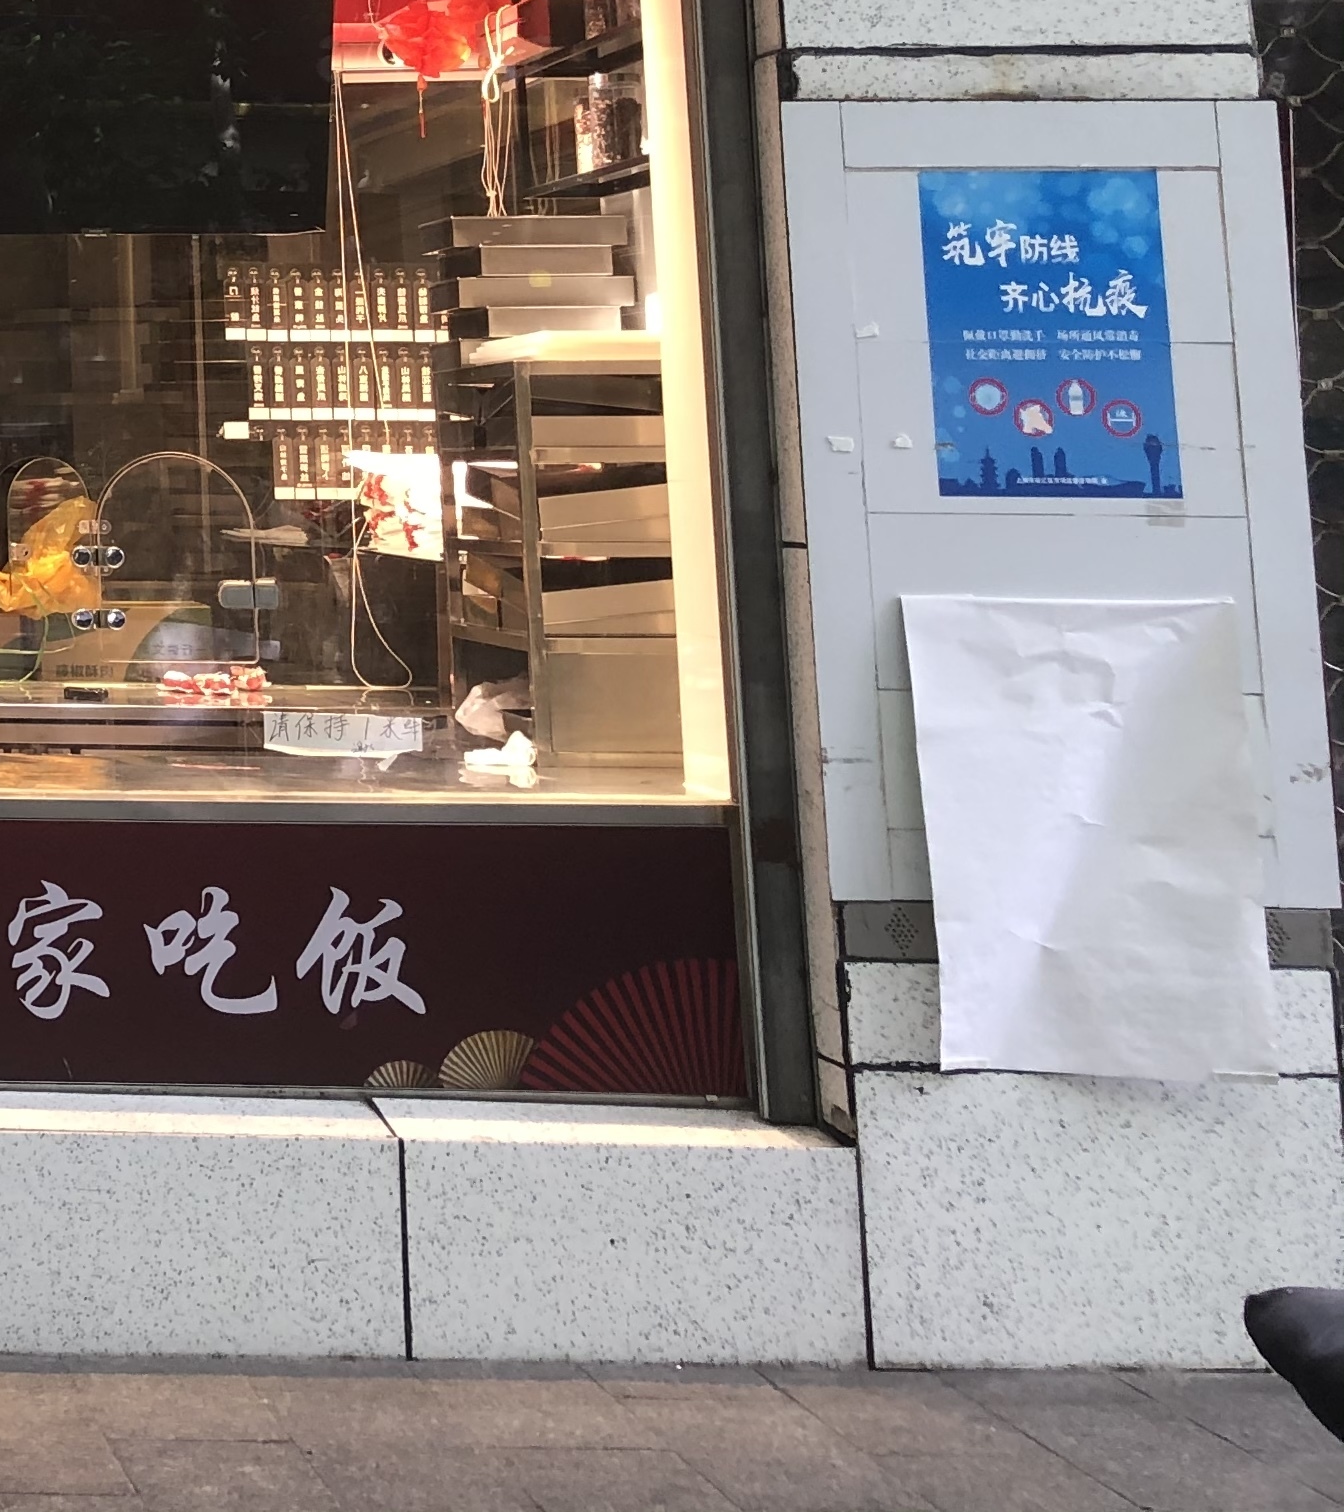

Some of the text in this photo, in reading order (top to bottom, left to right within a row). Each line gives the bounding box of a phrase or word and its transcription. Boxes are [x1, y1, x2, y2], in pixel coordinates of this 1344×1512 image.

[941, 219, 1081, 268] 筑牢防线
[999, 269, 1149, 320] 齐心抗疫
